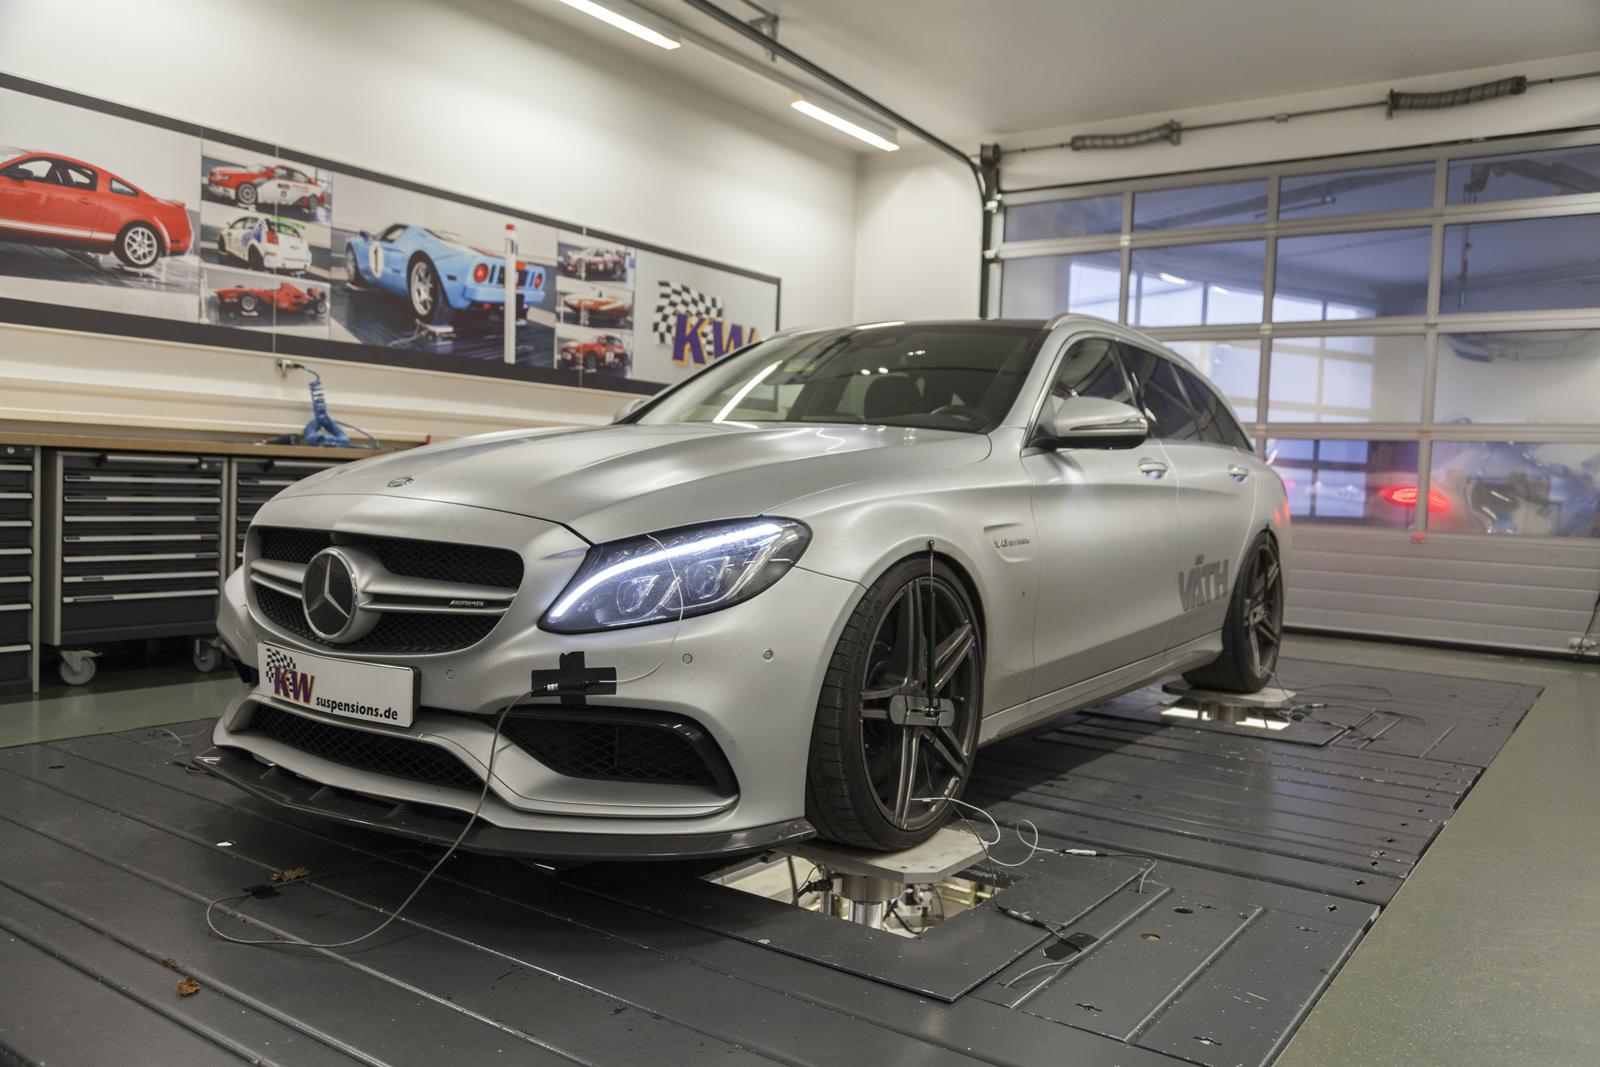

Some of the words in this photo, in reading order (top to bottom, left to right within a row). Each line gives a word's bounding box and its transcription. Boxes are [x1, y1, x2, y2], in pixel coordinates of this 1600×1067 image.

[672, 312, 758, 367] KW
[1178, 553, 1229, 612] VÄTH
[273, 666, 315, 704] KW
[316, 697, 398, 720] suspensions.de
